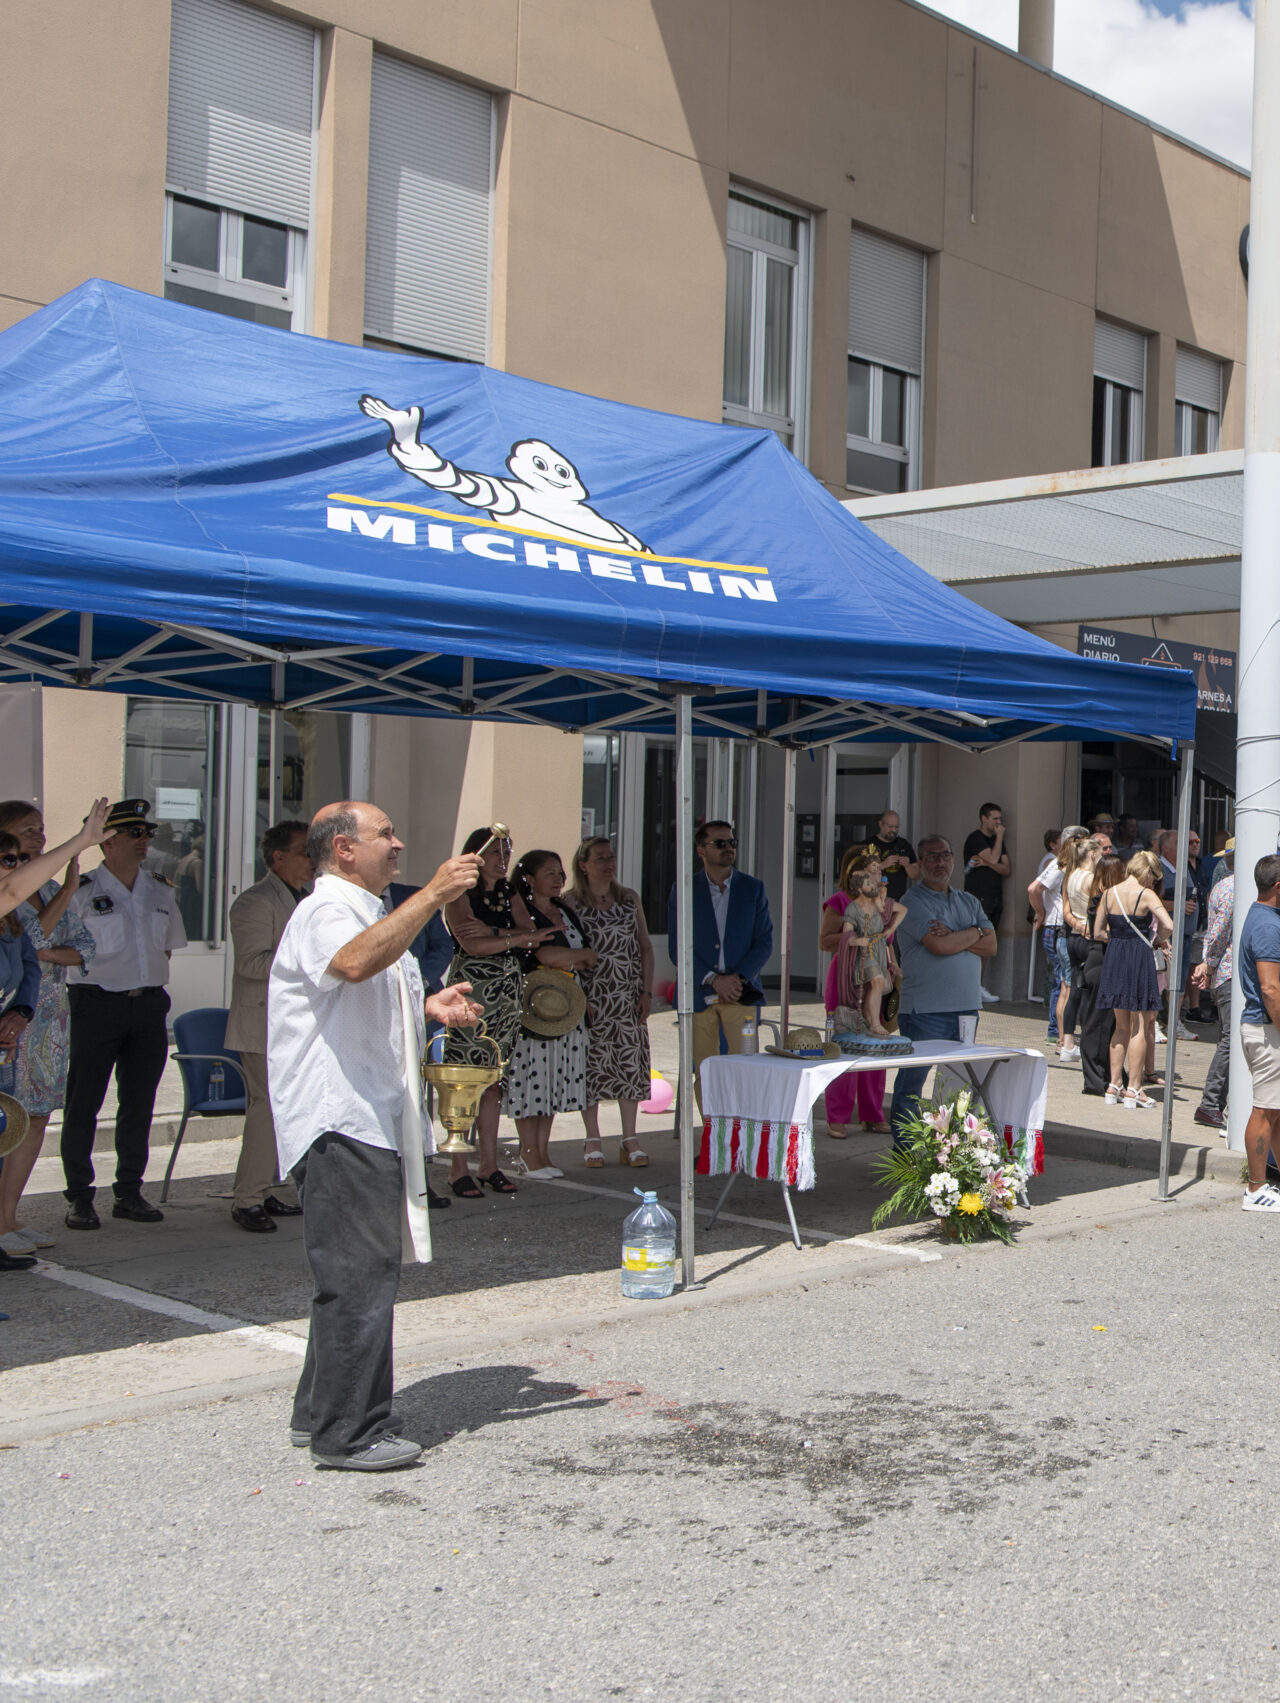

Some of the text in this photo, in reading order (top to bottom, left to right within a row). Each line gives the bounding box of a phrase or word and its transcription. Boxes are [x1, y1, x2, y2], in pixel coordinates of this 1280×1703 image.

[326, 506, 778, 602] MICHELIN
[1083, 632, 1116, 647] MENÚ
[1083, 649, 1120, 662] DIARIO
[1197, 689, 1225, 702] ARNES
